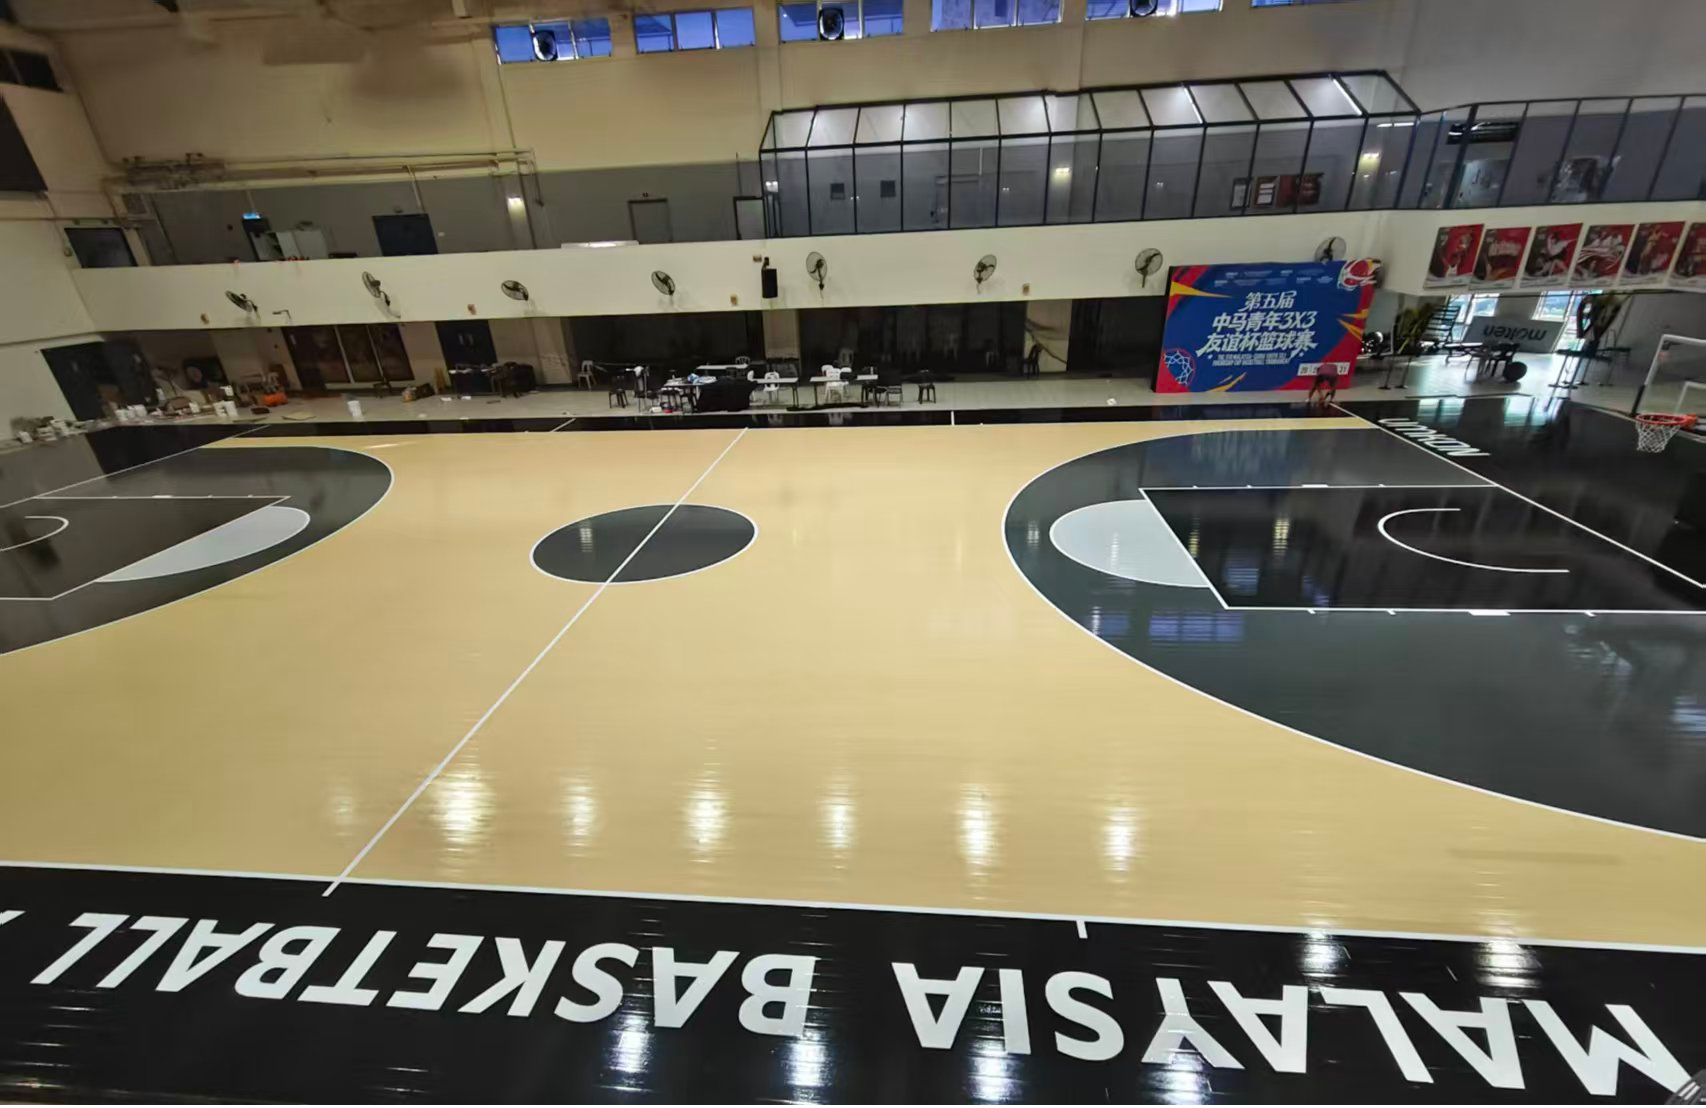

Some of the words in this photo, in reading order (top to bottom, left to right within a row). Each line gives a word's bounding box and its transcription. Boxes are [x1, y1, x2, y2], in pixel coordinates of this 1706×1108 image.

[1238, 290, 1297, 312] 第五届
[1212, 311, 1318, 332] 中马青年3X3
[1196, 328, 1319, 357] 友谊杯篮球赛
[30, 912, 818, 1036] BASKETBALL
[892, 963, 1691, 1096] MALAYSIA
